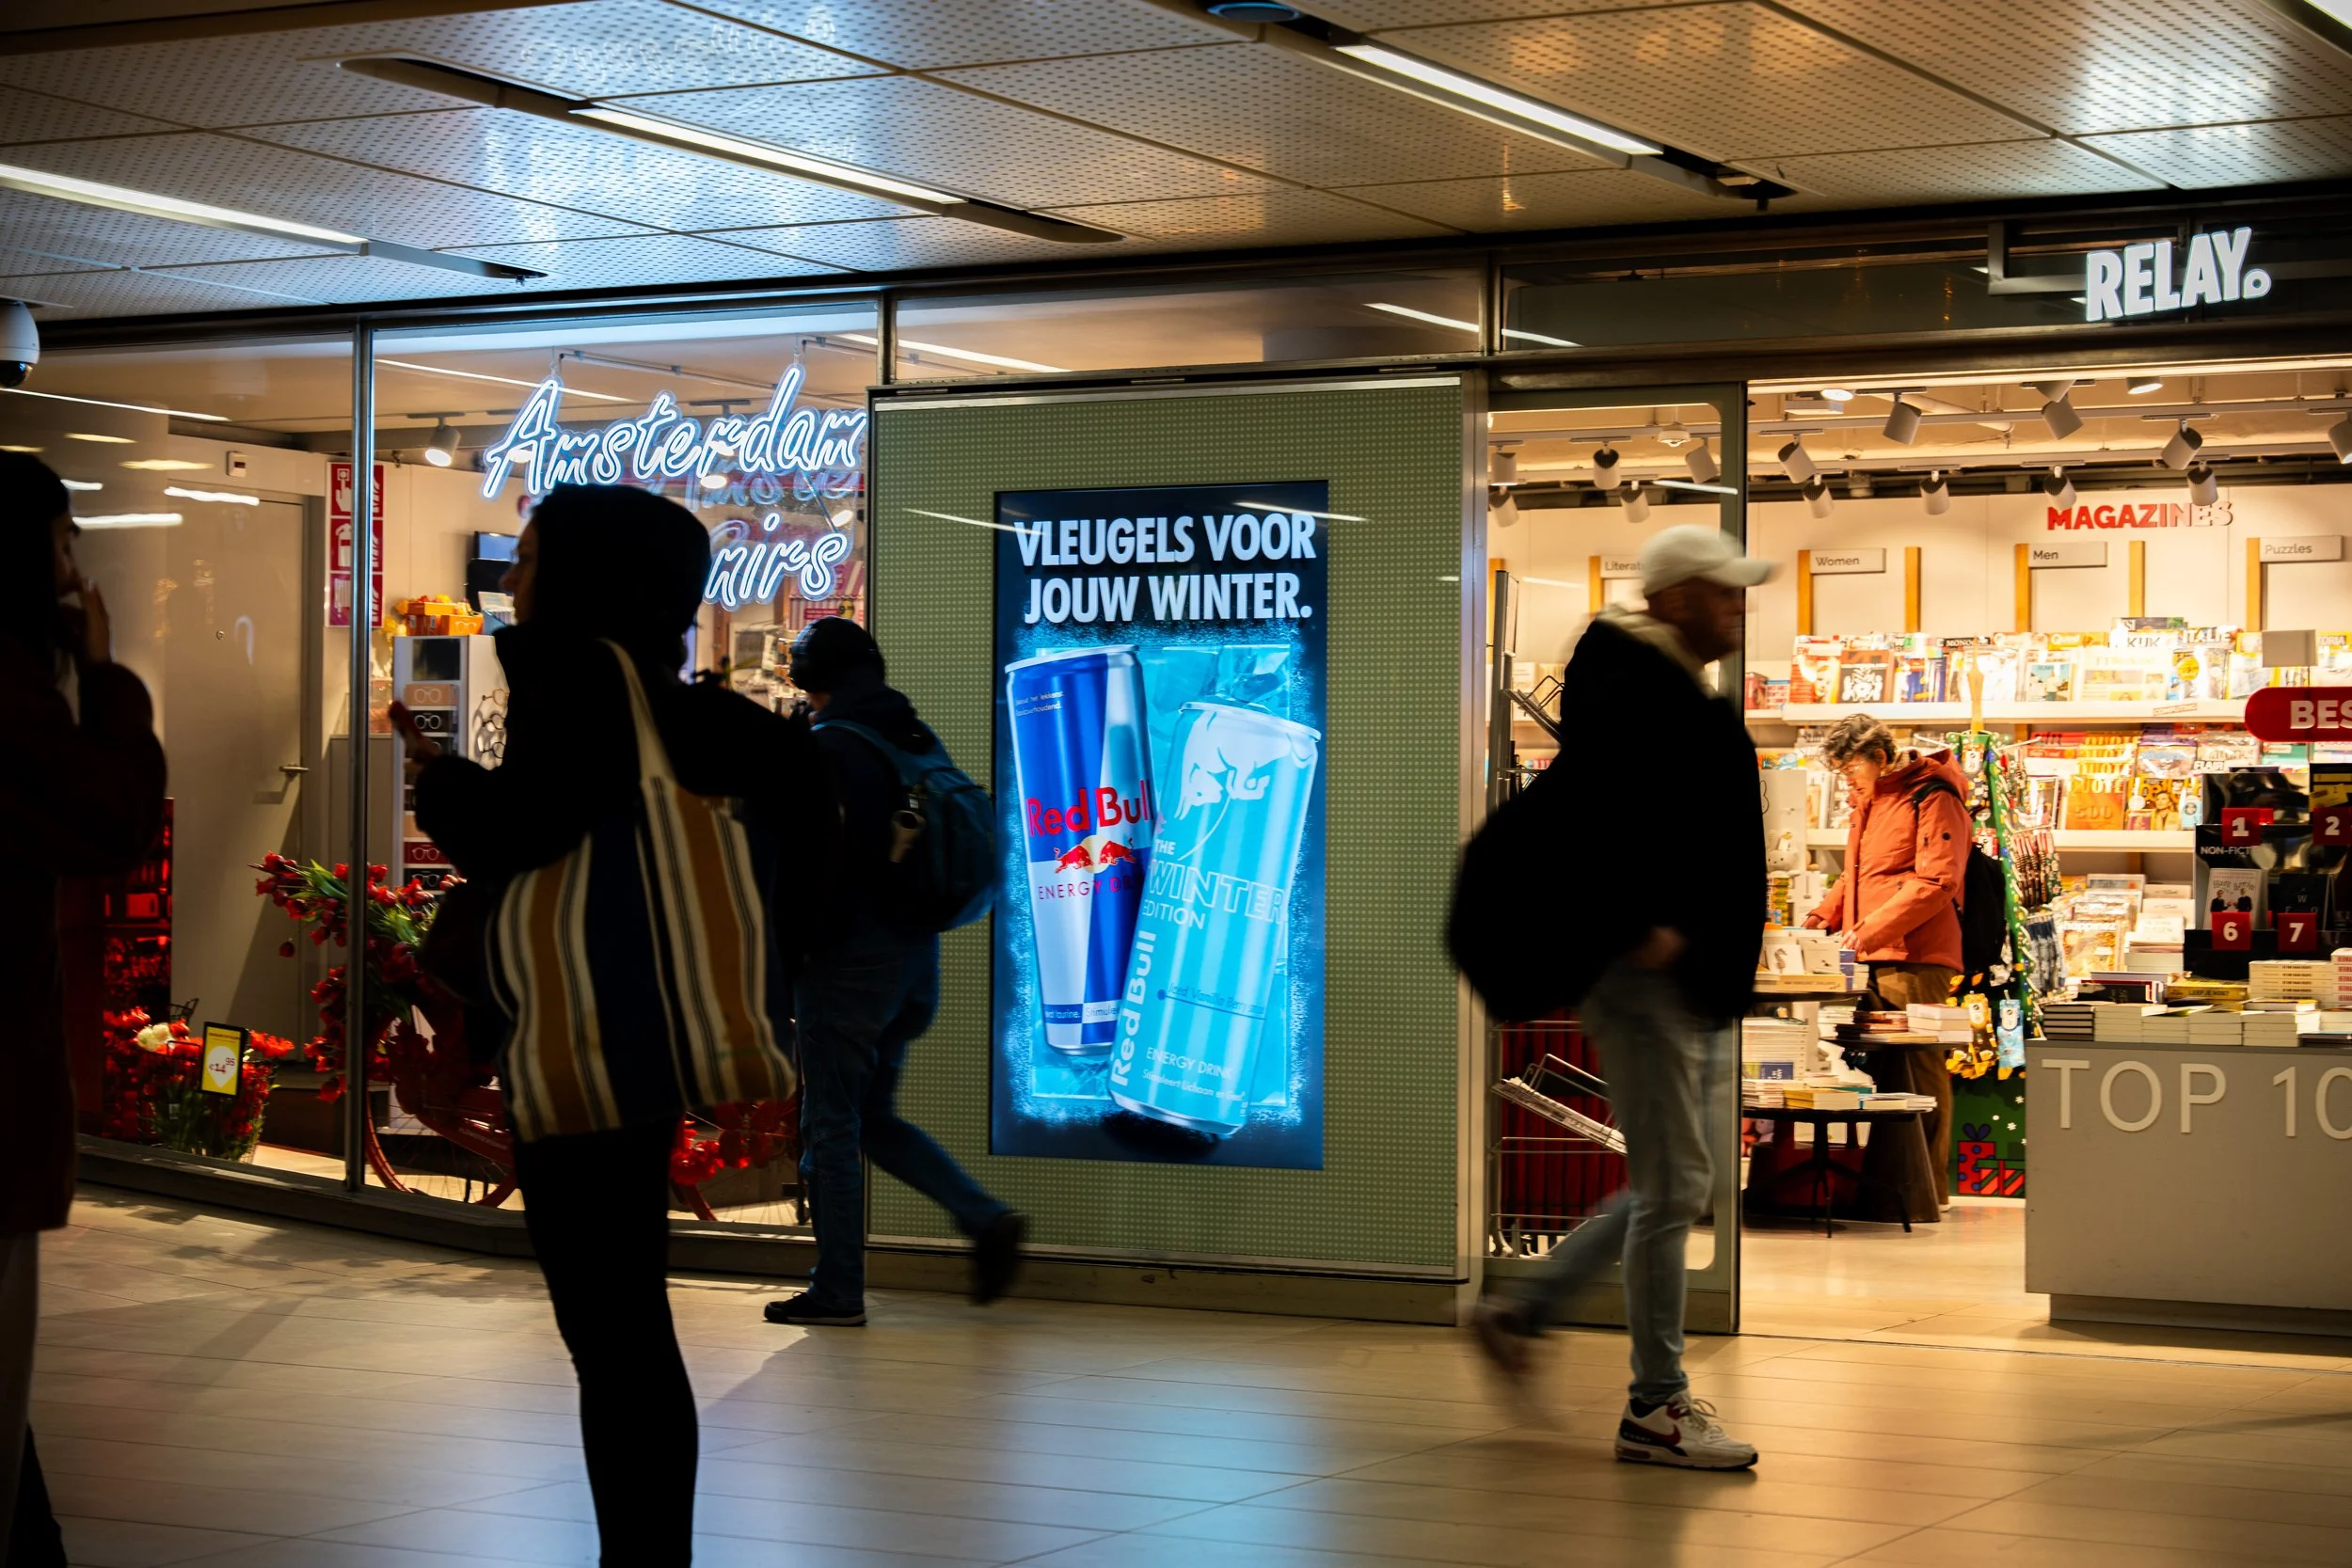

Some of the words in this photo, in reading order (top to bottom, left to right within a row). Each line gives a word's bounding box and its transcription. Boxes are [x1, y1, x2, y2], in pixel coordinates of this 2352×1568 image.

[481, 366, 867, 499] Amsterdam
[2047, 500, 2233, 531] MAGAZINES
[1014, 516, 1196, 566] VLEUGELS
[1203, 514, 1317, 562] VOOR
[2265, 543, 2313, 556] Puzzles
[704, 512, 848, 607] nirs
[1604, 561, 1642, 571] Literat
[1816, 555, 1860, 567] Women
[2033, 550, 2058, 561] Men
[1025, 576, 1140, 625] JOUW
[1148, 572, 1313, 621] WINTER.
[2317, 636, 2345, 646] TORIA
[1026, 787, 1091, 837] Red
[2232, 817, 2249, 837] 1
[2325, 816, 2341, 836] 2
[1154, 838, 1176, 856] THE
[2200, 847, 2250, 855] NON-FICT
[1038, 879, 1103, 900] ENERGY
[1148, 858, 1285, 925] WINTER
[1142, 898, 1206, 930] EDITION
[2222, 921, 2239, 942] 6
[2289, 922, 2305, 942] 7
[1126, 929, 1157, 1006] Bull
[1111, 1007, 1142, 1087] Red
[1146, 1046, 1197, 1071] ENERGY
[1198, 1060, 1233, 1080] DRINK
[2042, 1058, 2227, 1133] TOP
[2272, 1065, 2352, 1140] 10
